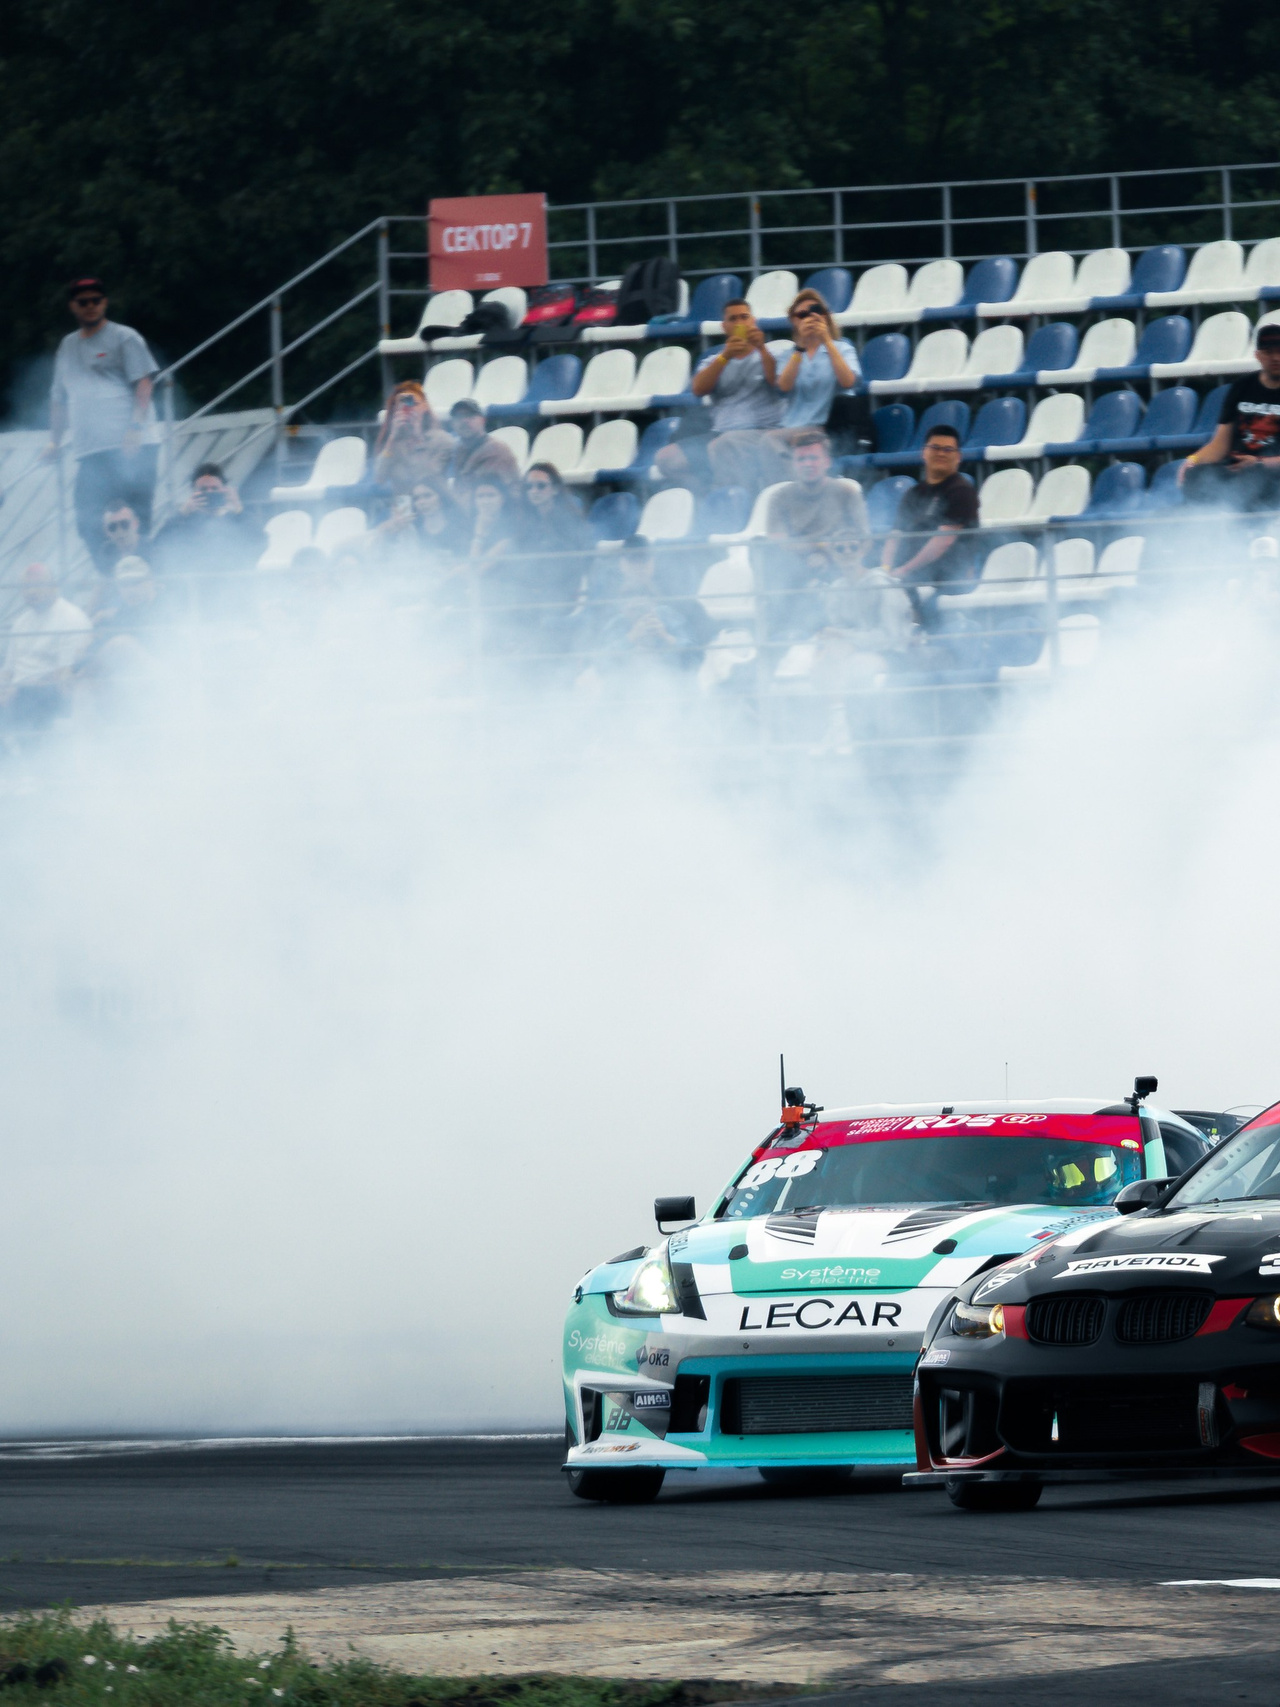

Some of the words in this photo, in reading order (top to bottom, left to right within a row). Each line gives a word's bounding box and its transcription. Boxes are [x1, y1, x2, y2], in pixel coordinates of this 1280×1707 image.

[443, 223, 518, 253] СЕКТОР
[519, 222, 532, 248] 7
[902, 1114, 1004, 1130] RDS
[1001, 1114, 1047, 1124] GP
[737, 1149, 823, 1190] 88
[1072, 1256, 1201, 1272] RAVENOL
[780, 1265, 881, 1280] Systême
[810, 1274, 879, 1285] electric
[739, 1298, 902, 1331] LECAR
[568, 1329, 626, 1355] Systême
[635, 1394, 667, 1406] AIMOL
